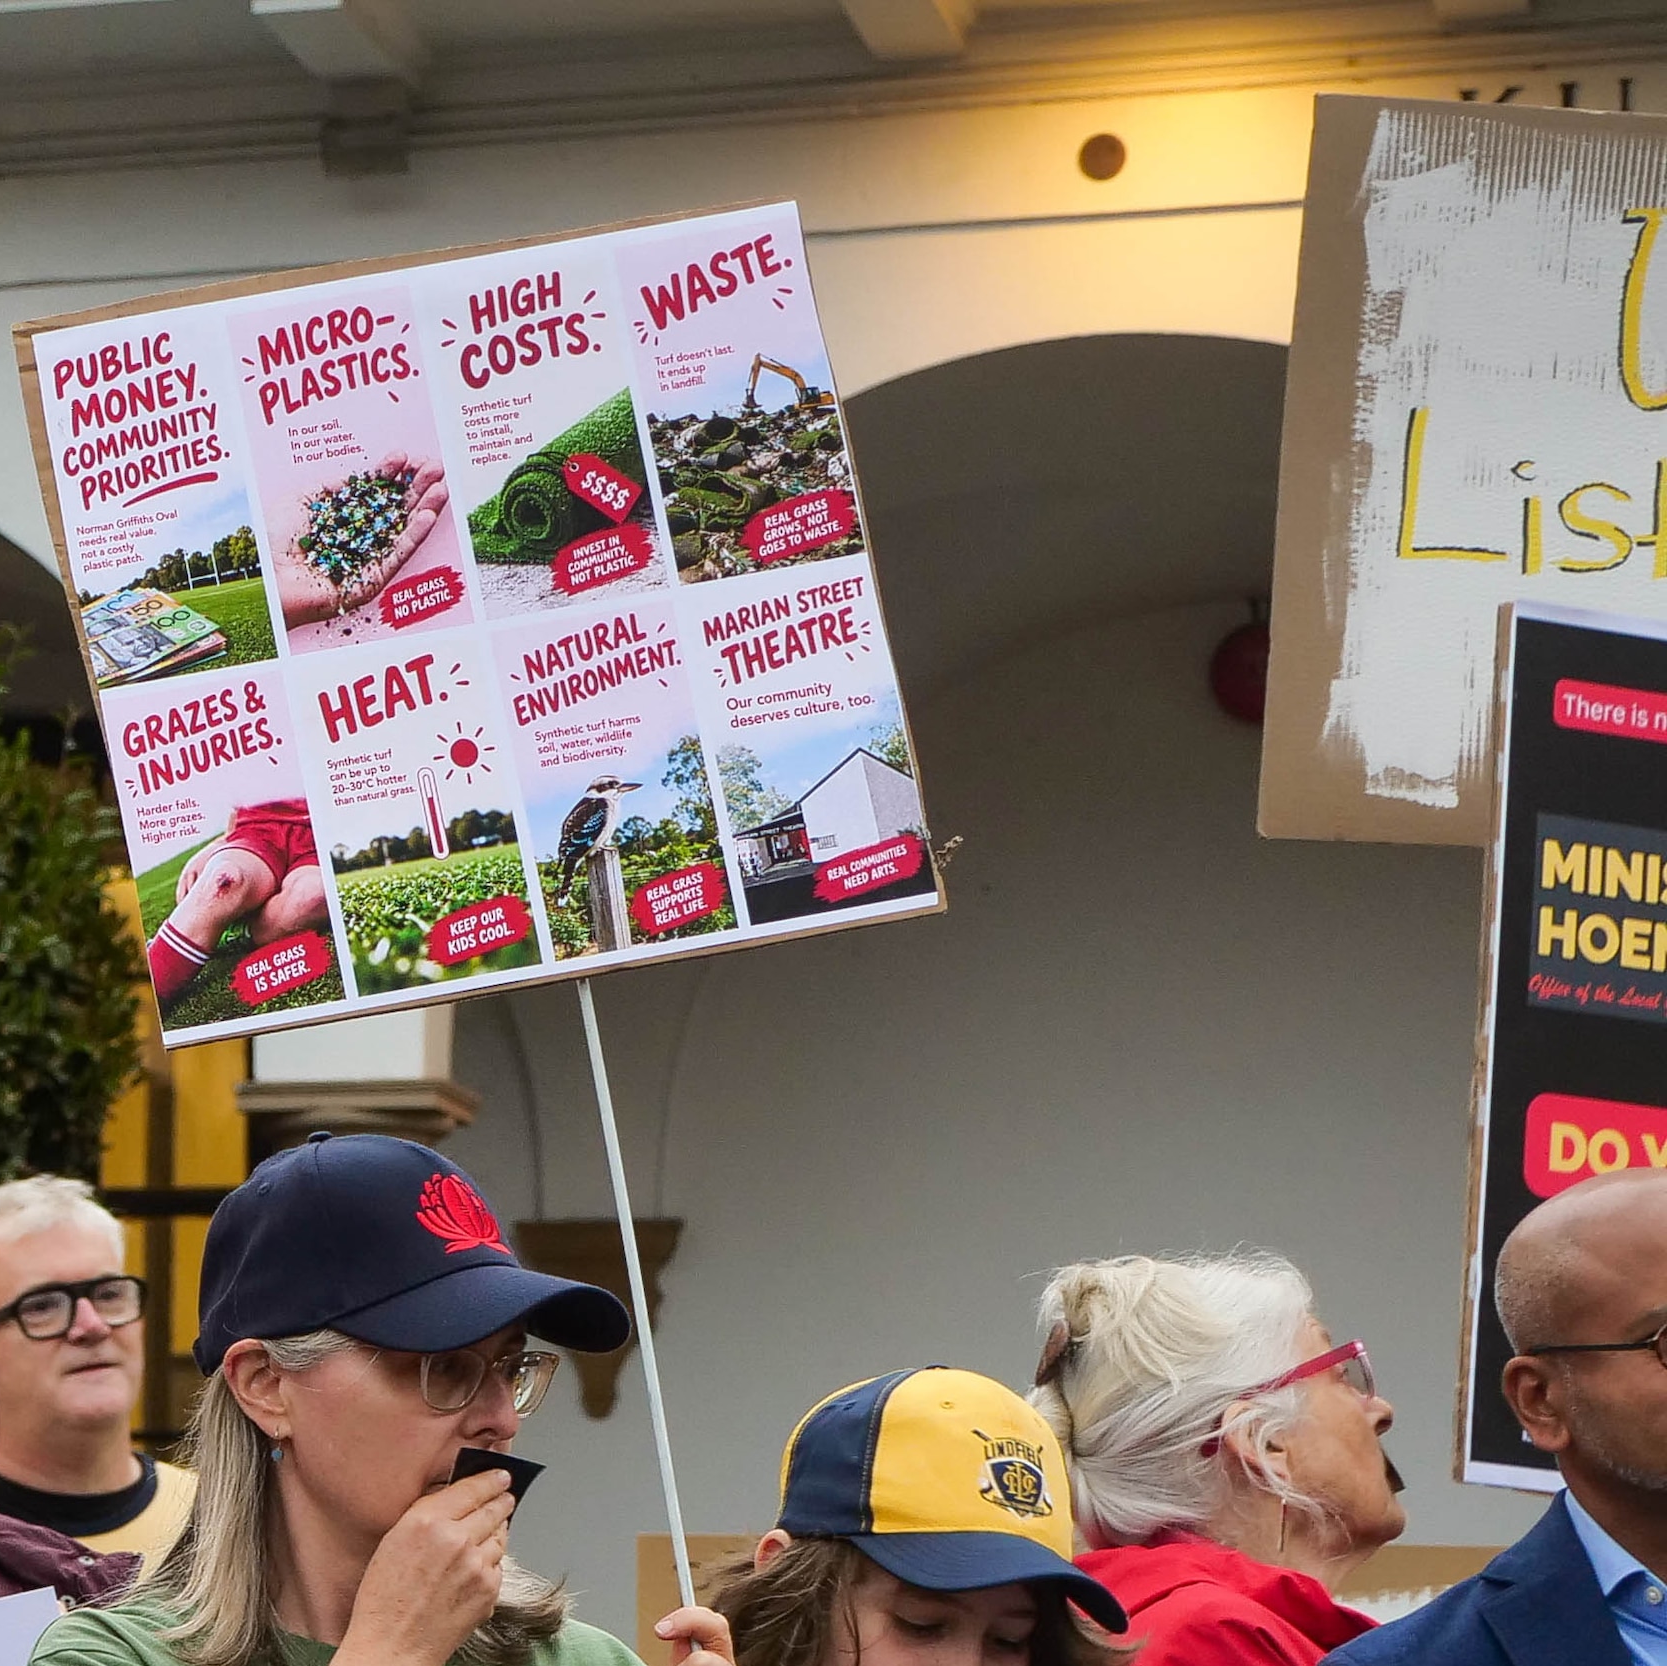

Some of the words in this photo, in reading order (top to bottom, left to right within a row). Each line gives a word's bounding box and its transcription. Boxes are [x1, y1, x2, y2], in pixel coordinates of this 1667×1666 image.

[641, 235, 792, 330] WASTE.
[469, 272, 561, 334] HIGH
[258, 306, 394, 375] MICRO-
[460, 313, 601, 389] COSTS.
[54, 332, 173, 400] PUBLIC
[655, 354, 673, 365] Turf
[714, 346, 734, 355] last.
[259, 343, 419, 425] PLASTICS.
[658, 370, 665, 378] It
[667, 365, 691, 376] ends
[693, 365, 706, 374] up
[660, 382, 669, 391] in
[671, 375, 705, 389] landfill.
[71, 363, 207, 437] MONEY.
[462, 399, 510, 417] Synthetic
[513, 393, 531, 405] turf
[288, 428, 298, 437] In
[301, 425, 318, 434] our
[321, 419, 342, 431] soil.
[465, 417, 490, 427] costs
[493, 412, 519, 422] more
[466, 432, 478, 440] to
[480, 424, 513, 437] install,
[63, 403, 216, 476] COMMUNITY
[291, 441, 300, 450] In
[304, 439, 320, 448] our
[324, 433, 355, 444] water.
[469, 438, 511, 452] maintain
[515, 433, 533, 444] and
[293, 454, 303, 463] In
[306, 452, 323, 461] our
[326, 445, 364, 458] bodies.
[472, 453, 511, 466] replace.
[80, 434, 230, 510] PRIORITIES.
[581, 471, 629, 510] $$$$
[76, 523, 114, 535] Norman
[117, 515, 154, 528] Griffiths
[156, 509, 177, 521] Oval
[764, 520, 804, 541] GROWS,
[807, 511, 828, 526] NOT
[765, 512, 791, 528] REAL
[794, 499, 827, 518] GRASS
[79, 535, 107, 547] needs
[109, 531, 126, 542] real
[81, 550, 97, 559] not
[107, 543, 134, 554] costly
[573, 539, 605, 559] INVEST
[609, 535, 619, 547] IN
[759, 539, 786, 556] GOES
[788, 534, 801, 546] TO
[804, 520, 842, 540] WASTE.
[84, 559, 113, 573] plastic
[116, 553, 144, 568] patch.
[568, 545, 628, 573] COMMUNITY,
[571, 569, 590, 585] NOT
[594, 555, 638, 577] PLASTIC.
[393, 589, 415, 604] REAL
[417, 577, 447, 595] GRASS.
[395, 605, 409, 619] NO
[411, 589, 453, 613] PLASTIC.
[150, 610, 191, 630] 100
[703, 595, 790, 646] MARIAN
[797, 577, 863, 613] STREET
[523, 613, 647, 684] NATURAL
[721, 606, 858, 684] THEATRE
[513, 639, 681, 726] ENVIRONMENT.
[727, 698, 752, 710] Our
[757, 683, 831, 705] community
[318, 654, 448, 743] HEAT.
[731, 710, 790, 728] deserves
[794, 701, 844, 716] culture,
[848, 695, 875, 707] too.
[1563, 693, 1626, 725] There
[1631, 702, 1648, 729] is
[123, 689, 238, 757] GRAZES
[244, 681, 266, 713] &
[535, 725, 583, 743] Synthetic
[586, 719, 605, 732] turf
[608, 716, 641, 728] harms
[538, 742, 558, 754] soil,
[561, 739, 592, 749] water,
[595, 729, 632, 743] wildlife
[138, 717, 282, 795] INJURIES.
[327, 754, 372, 770] Synthetic
[374, 749, 391, 760] turf
[541, 755, 559, 767] and
[563, 746, 626, 763] biodiversity.
[330, 773, 346, 781] can
[349, 769, 361, 778] be
[364, 767, 377, 776] up
[376, 775, 406, 786] hotter
[136, 804, 172, 817] Harder
[176, 798, 199, 809] falls.
[334, 797, 355, 806] than
[357, 789, 388, 802] natural
[390, 786, 416, 798] grass.
[139, 820, 166, 830] More
[169, 813, 205, 827] grazes.
[142, 831, 176, 844] Higher
[180, 825, 200, 836] risk.
[827, 866, 849, 880] REAL
[850, 844, 907, 872] COMMUNITIES
[844, 872, 868, 889] NEED
[872, 862, 898, 880] ARTS.
[1541, 838, 1667, 905] MINI
[647, 884, 671, 901] REAL
[673, 872, 703, 890] GRASS
[652, 885, 703, 913] SUPPORTS
[450, 916, 477, 936] KEEP
[481, 908, 504, 925] OUR
[656, 908, 681, 925] REAL
[683, 898, 707, 914] LIFE.
[448, 934, 476, 955] KIDS
[479, 923, 514, 943] COOL.
[246, 959, 271, 978] REAL
[273, 945, 305, 966] GRASS
[255, 977, 267, 992] IS
[270, 960, 310, 986] SAFER.
[1549, 1121, 1630, 1175] DO
